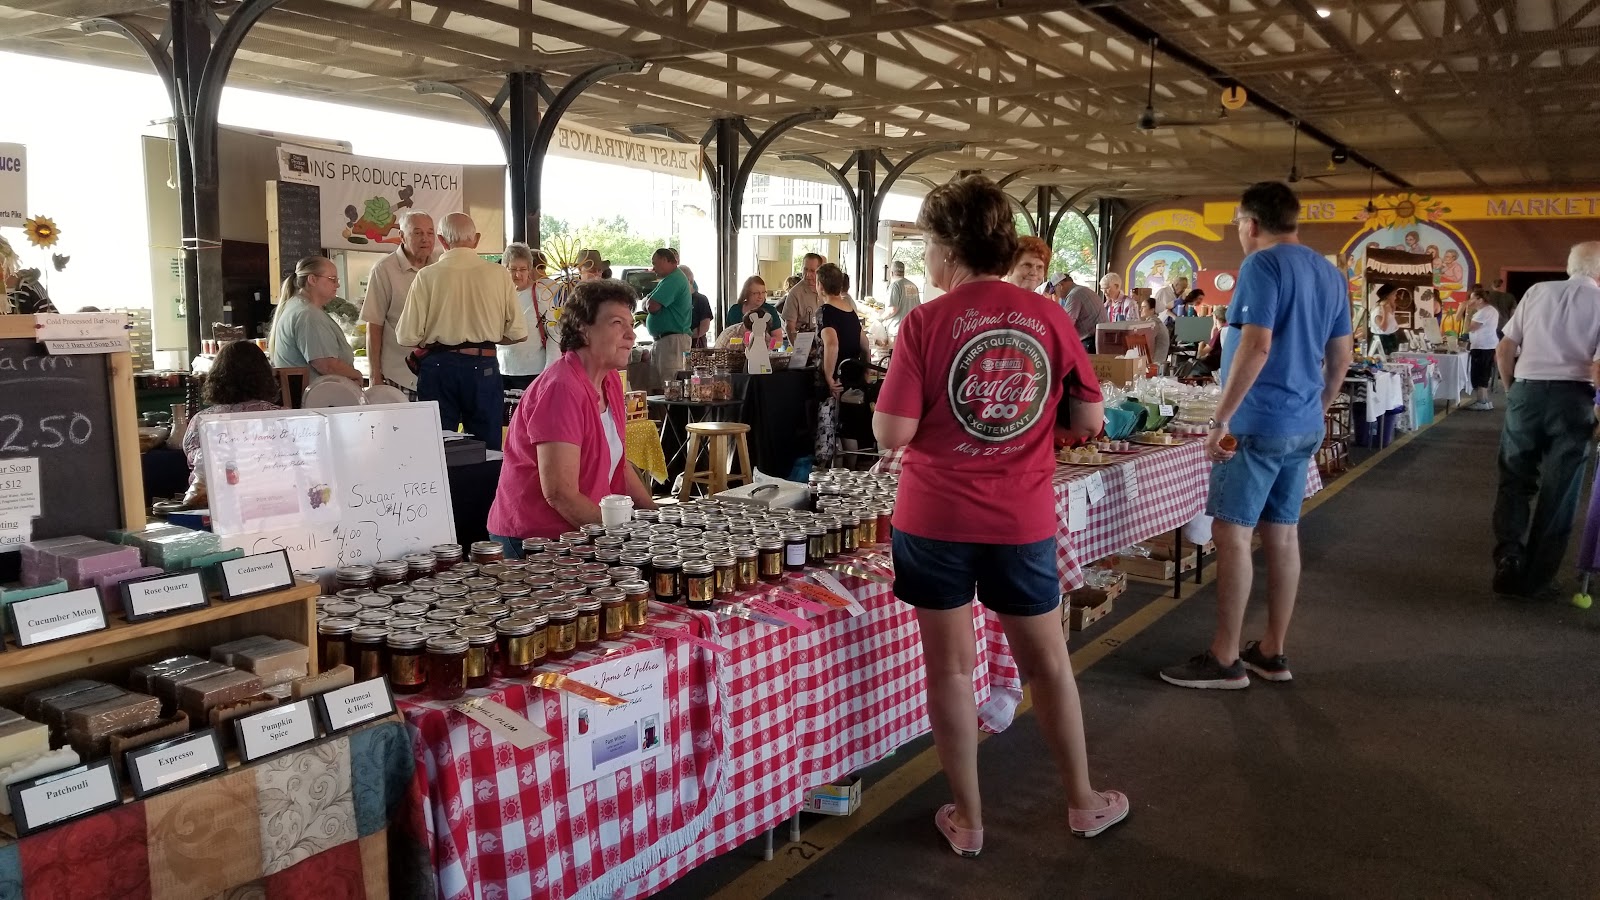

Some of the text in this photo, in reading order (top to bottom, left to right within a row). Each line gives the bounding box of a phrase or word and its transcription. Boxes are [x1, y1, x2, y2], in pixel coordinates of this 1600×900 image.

[310, 159, 458, 190] N'S PRODUCE PATCH
[1487, 197, 1600, 216] MARKET
[742, 213, 812, 229] ETTLE CORN
[1171, 213, 1196, 229] 1985
[964, 308, 979, 318] The
[952, 311, 1046, 339] Original Classic
[960, 341, 988, 370] THIRST
[990, 337, 1043, 369] QUENCHING
[981, 403, 1019, 419] 600
[966, 413, 1031, 434] EXCITEMENT
[0, 412, 92, 452] 2.50
[279, 428, 288, 439] &
[952, 442, 981, 457] May
[9, 464, 32, 473] Soap
[5, 480, 22, 489] $12
[349, 481, 438, 517] Sugar FREE
[386, 502, 428, 526] $4.50
[0, 535, 26, 544] Cards
[332, 523, 362, 550] $4.00
[237, 562, 274, 575] Cedarwood
[144, 581, 189, 596] Rose Quartz
[27, 607, 97, 628] Cucumber Melon
[600, 671, 621, 689] Jams
[623, 666, 632, 677] &
[634, 660, 659, 680] Jellies
[344, 691, 371, 705] Oatmeal
[354, 702, 374, 713] Honey
[615, 703, 628, 711] Every
[261, 717, 293, 733] Pumpkin
[495, 717, 519, 733] PLUM
[269, 729, 289, 741] Spice
[157, 748, 195, 767] Expresso
[45, 778, 90, 800] Patchouli
[787, 841, 824, 859] 21
